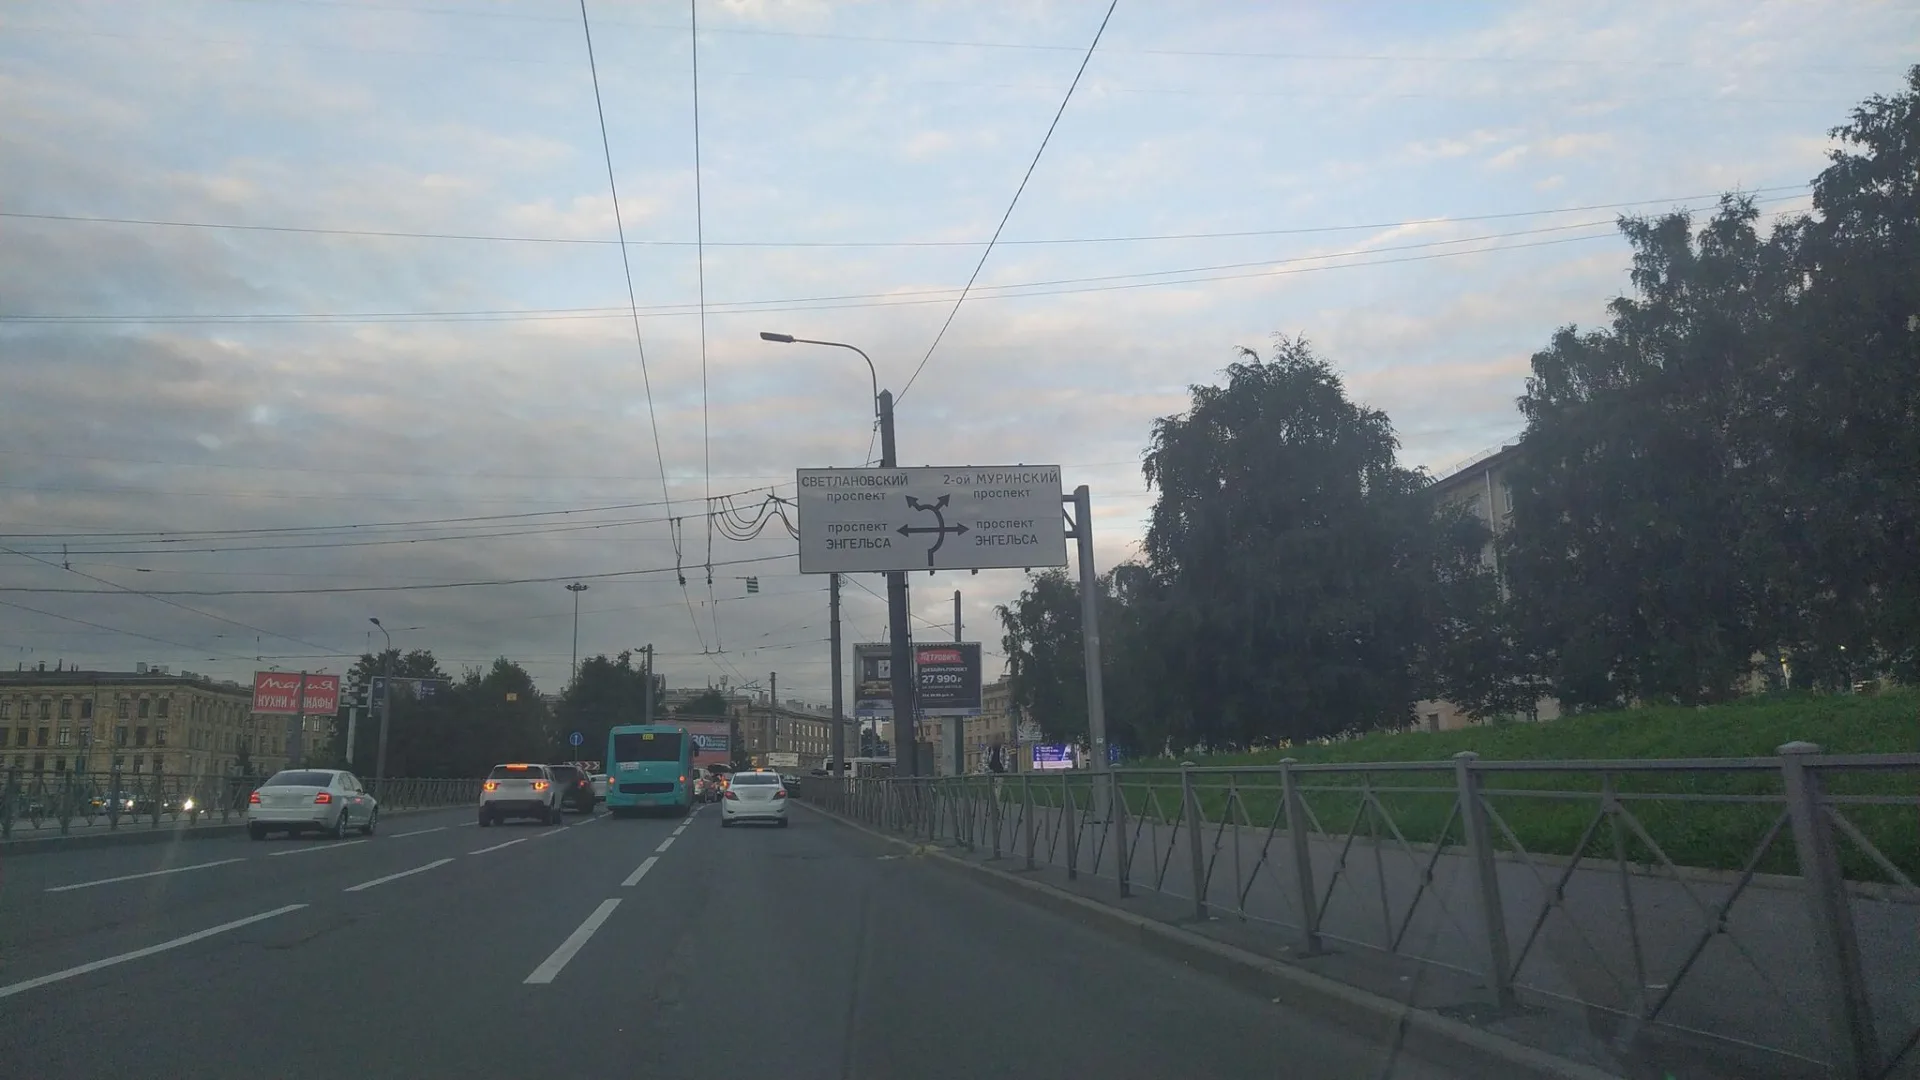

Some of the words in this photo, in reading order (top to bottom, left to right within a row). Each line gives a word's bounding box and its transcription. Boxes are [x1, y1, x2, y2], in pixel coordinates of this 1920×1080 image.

[801, 473, 909, 487] СВЕТЛАНОВСКИЙ
[943, 474, 971, 486] 2-ой
[976, 470, 1058, 484] МУРИНСКИЙ
[827, 491, 886, 502] проспект
[973, 488, 1031, 500] проспект
[828, 522, 888, 533] проспект
[976, 519, 1034, 530] проспект
[826, 538, 891, 550] ЭНГЕЛЬСА
[975, 534, 1038, 546] ЭНГЕЛЬСА
[922, 675, 934, 684] 27
